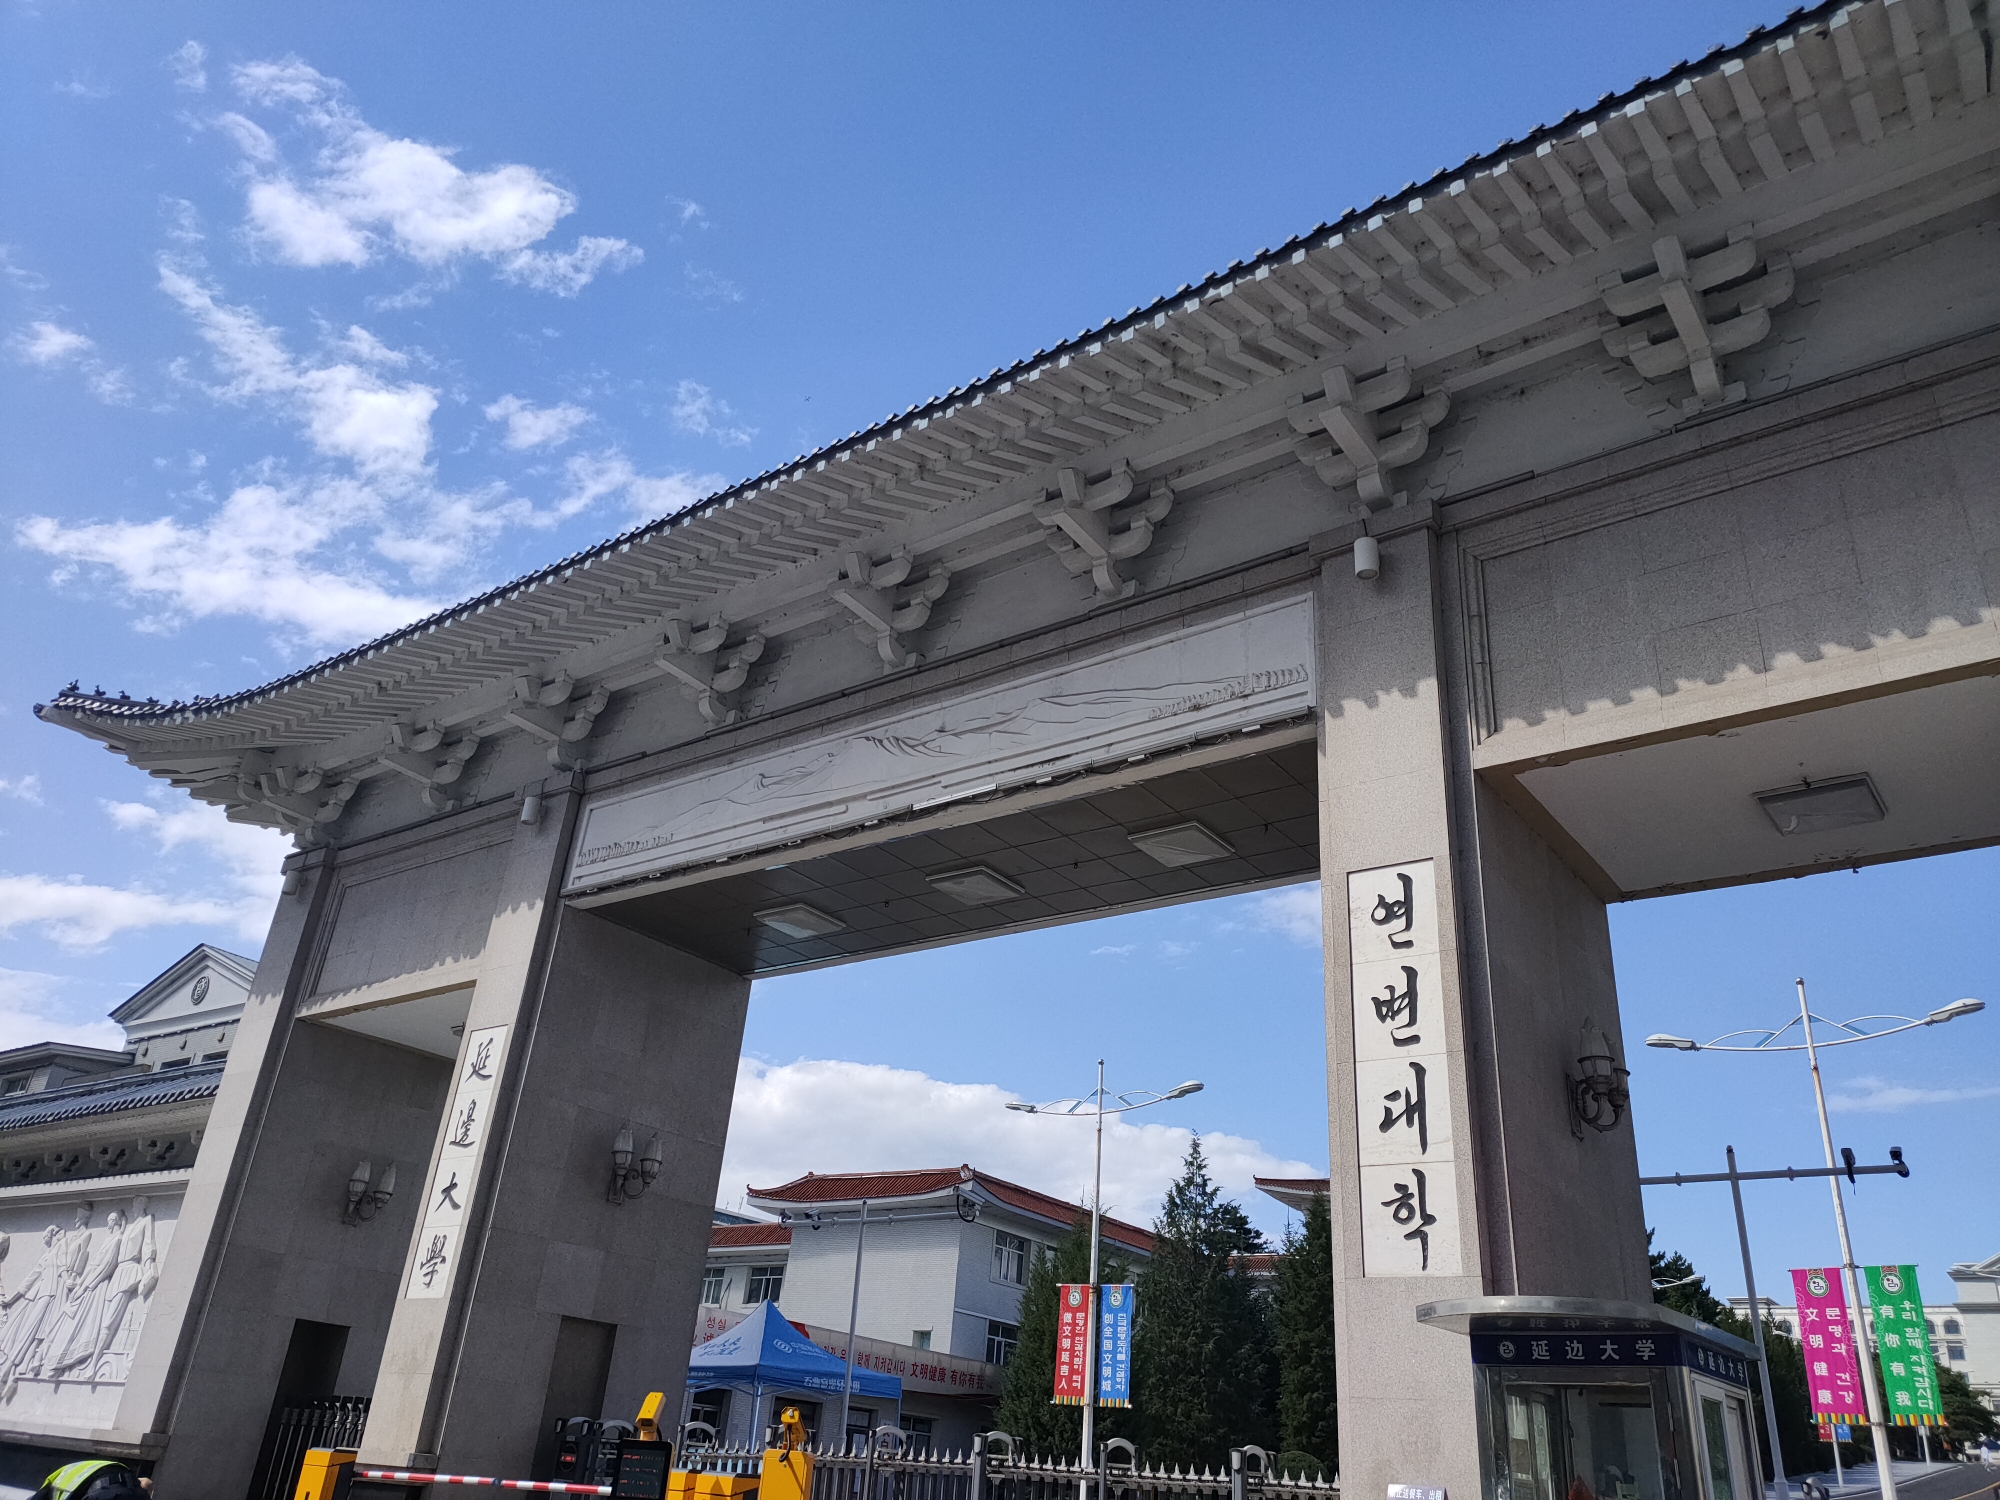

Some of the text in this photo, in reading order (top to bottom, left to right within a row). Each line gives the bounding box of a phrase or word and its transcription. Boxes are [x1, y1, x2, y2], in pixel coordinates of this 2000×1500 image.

[1371, 872, 1437, 1271] 연변대학
[420, 1037, 494, 1289] 延邊大學
[707, 1316, 727, 1331] 성실
[1900, 1300, 1917, 1321] 우리
[1904, 1327, 1923, 1349] 함께
[910, 1362, 984, 1390] 文明健康 有你有我
[1058, 1312, 1073, 1389] 做文明延吉人
[1102, 1313, 1114, 1391] 创全国文明城
[1531, 1339, 1656, 1361] 延边大学
[1707, 1351, 1745, 1381] 延边大学
[1805, 1308, 1833, 1404] 文明健康
[1825, 1307, 1846, 1356] 문명과
[1836, 1372, 1855, 1404] 건강
[1879, 1304, 1912, 1406] 有你有我
